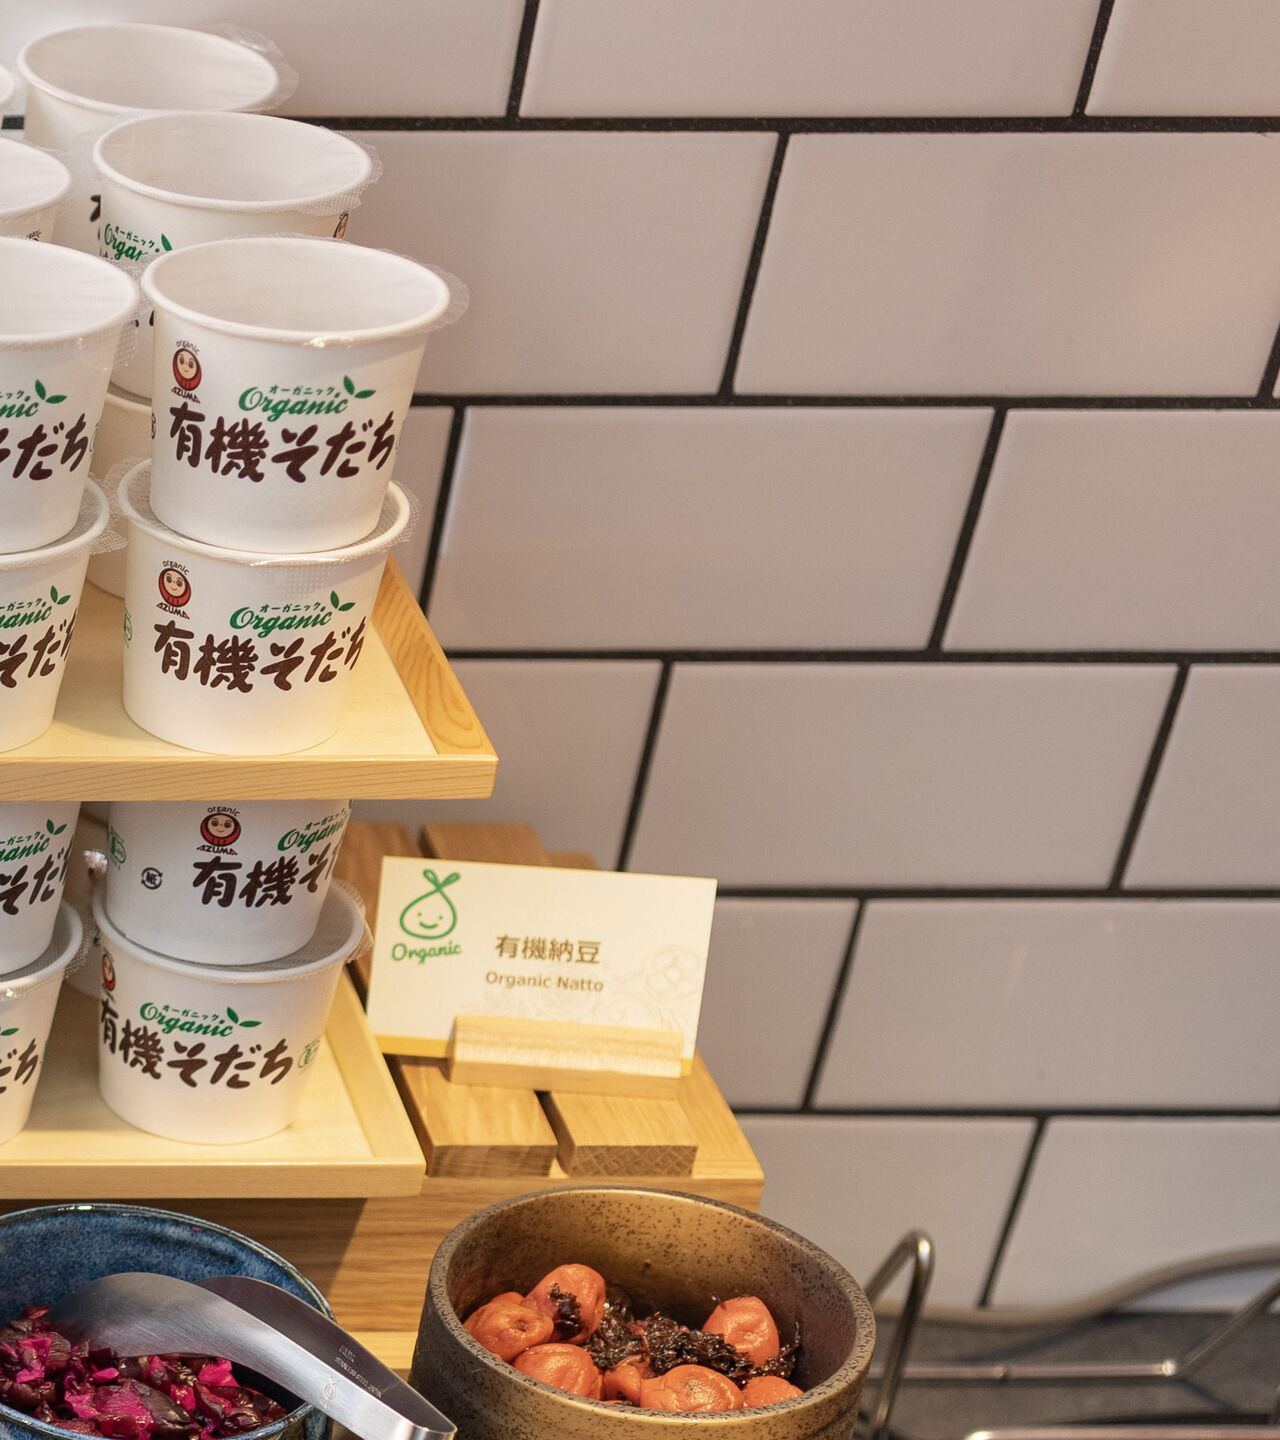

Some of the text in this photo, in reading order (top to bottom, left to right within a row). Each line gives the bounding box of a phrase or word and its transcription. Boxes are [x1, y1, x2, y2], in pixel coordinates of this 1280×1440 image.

[171, 386, 201, 404] AZUMA
[269, 385, 334, 395] オーガニック
[239, 387, 348, 422] Organic
[170, 402, 394, 483] 有機そだち
[163, 560, 190, 575] organic
[156, 602, 190, 619] AZUMA
[260, 602, 320, 613] オーガニック
[230, 607, 332, 638] Organic
[154, 616, 366, 693] 有機そだち
[208, 806, 240, 817] organic
[197, 845, 238, 855] AZUMA
[392, 942, 462, 964] Organic
[495, 935, 601, 964] 有機納豆
[486, 971, 604, 992] Organic Natto
[140, 1003, 233, 1037] Organic
[162, 1005, 219, 1022] オーガニック
[101, 998, 293, 1089] 有機そだち
